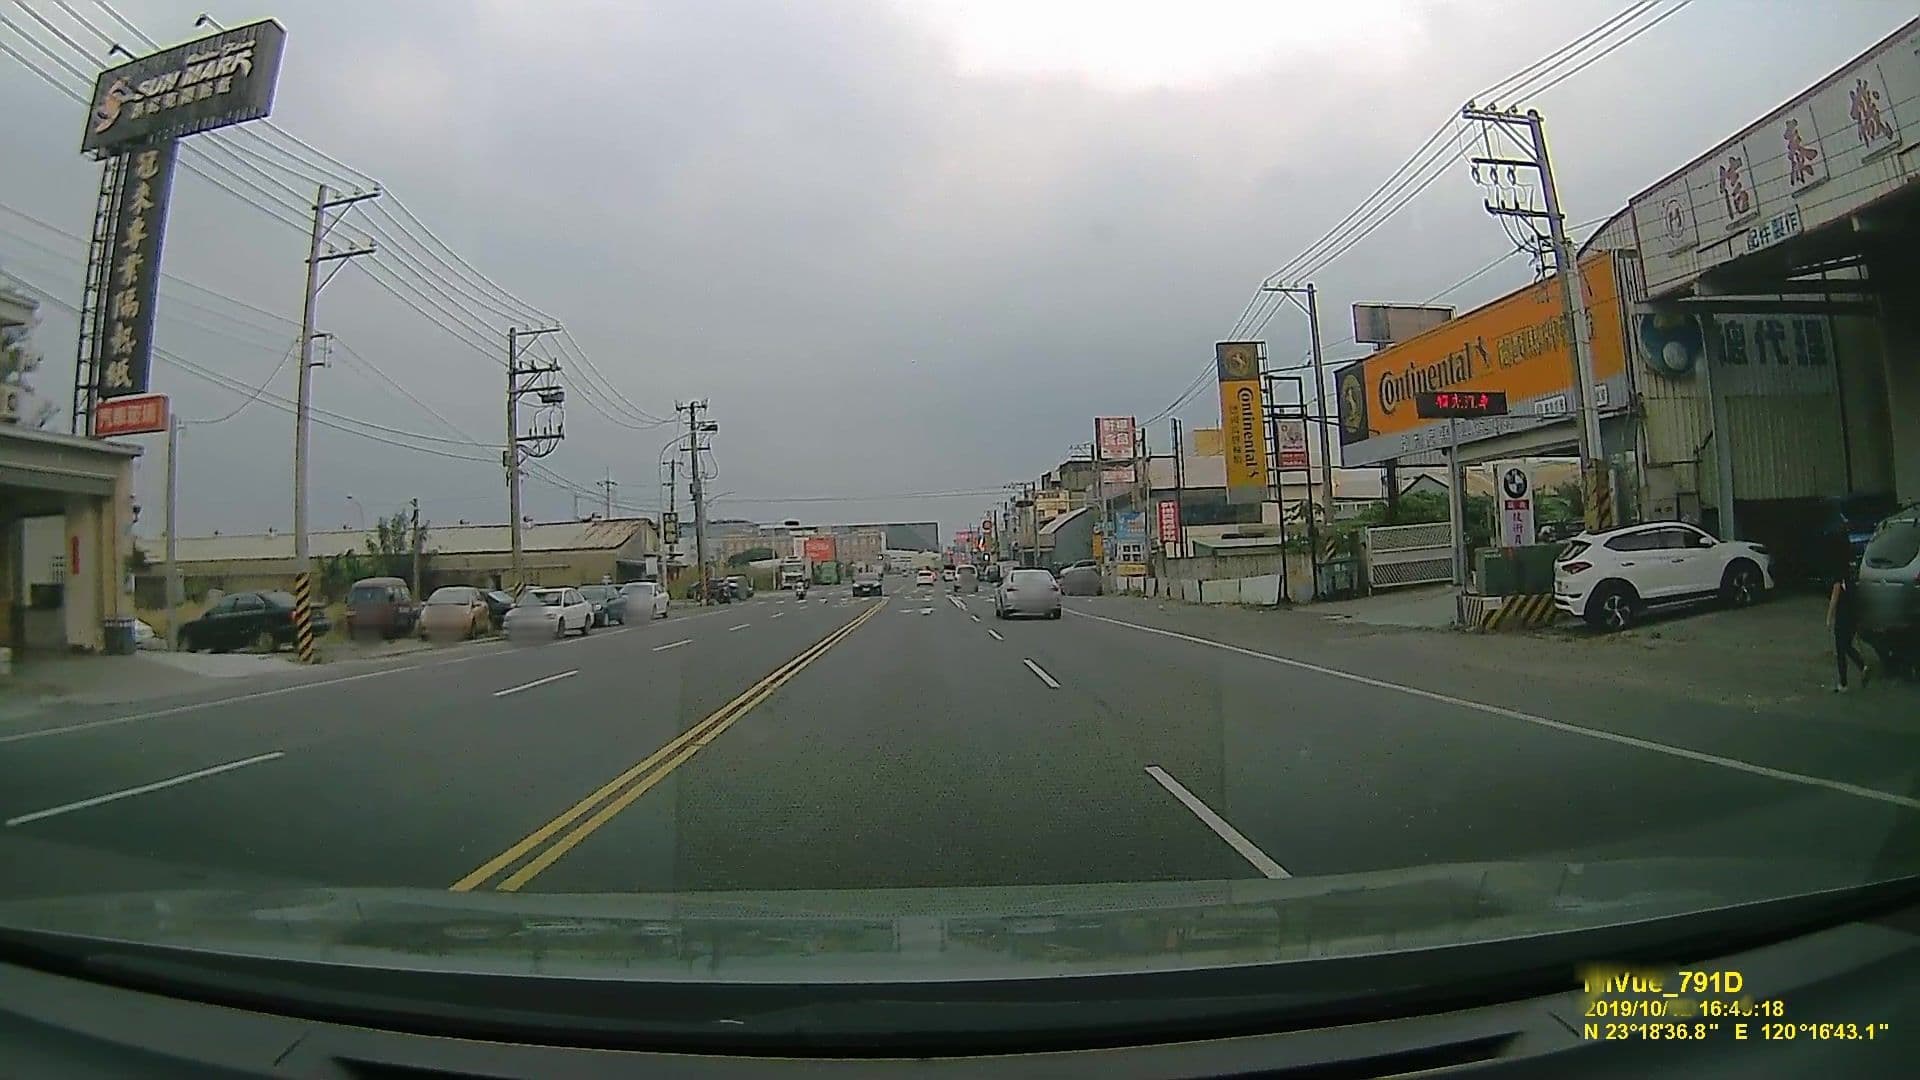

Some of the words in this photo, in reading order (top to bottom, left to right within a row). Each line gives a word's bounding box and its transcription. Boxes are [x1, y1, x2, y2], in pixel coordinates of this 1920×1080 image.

[132, 71, 181, 99] SUN
[177, 50, 254, 88] MARK
[1747, 212, 1797, 250] 配件製作
[1379, 342, 1473, 416] Continental
[1237, 387, 1259, 467] Continental
